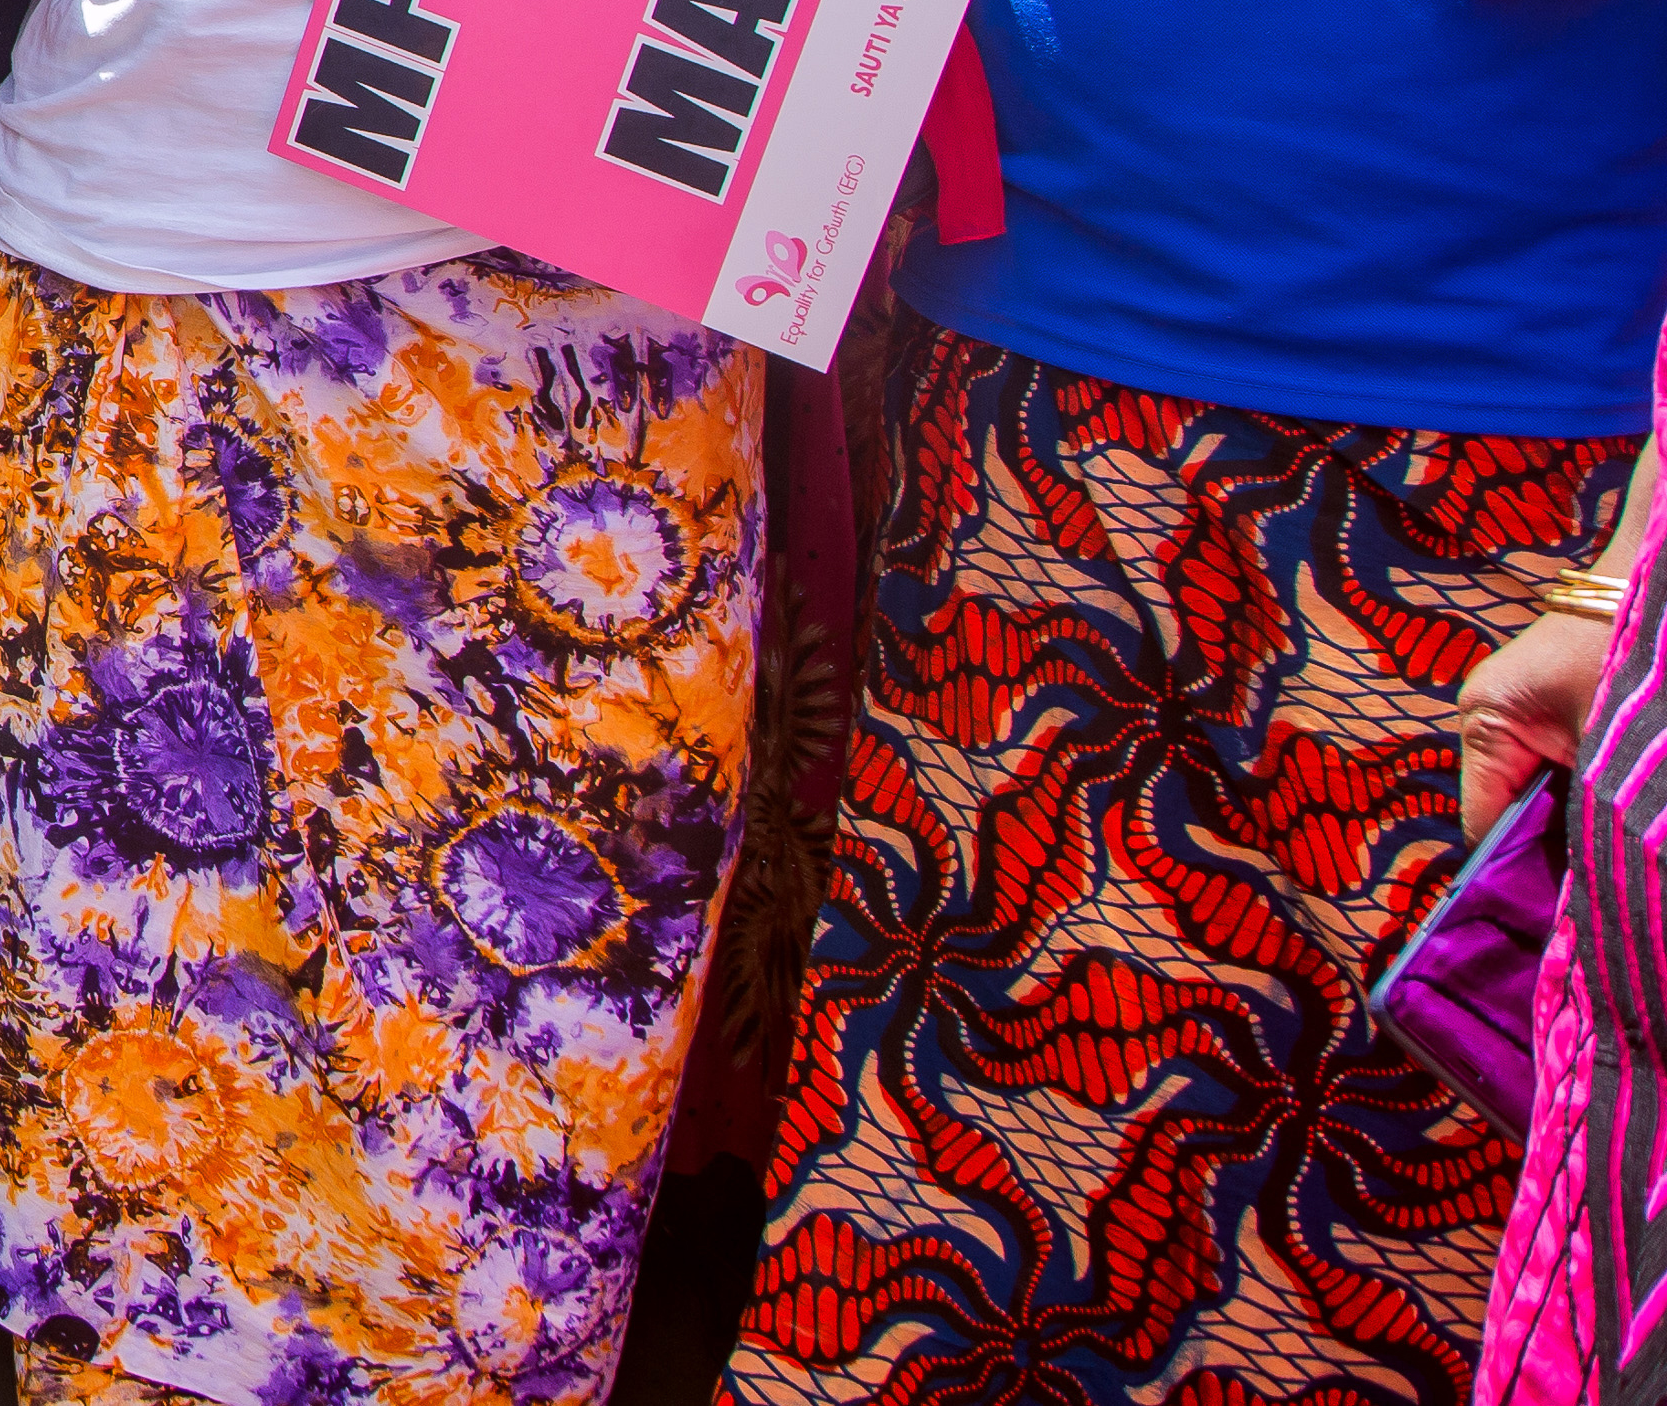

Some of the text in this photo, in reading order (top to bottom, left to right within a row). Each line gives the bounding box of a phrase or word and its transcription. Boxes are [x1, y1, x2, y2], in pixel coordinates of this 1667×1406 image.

[850, 33, 891, 98] SAUTI
[873, 4, 904, 29] YA
[780, 154, 865, 346] Equality for Growth (EfG)
